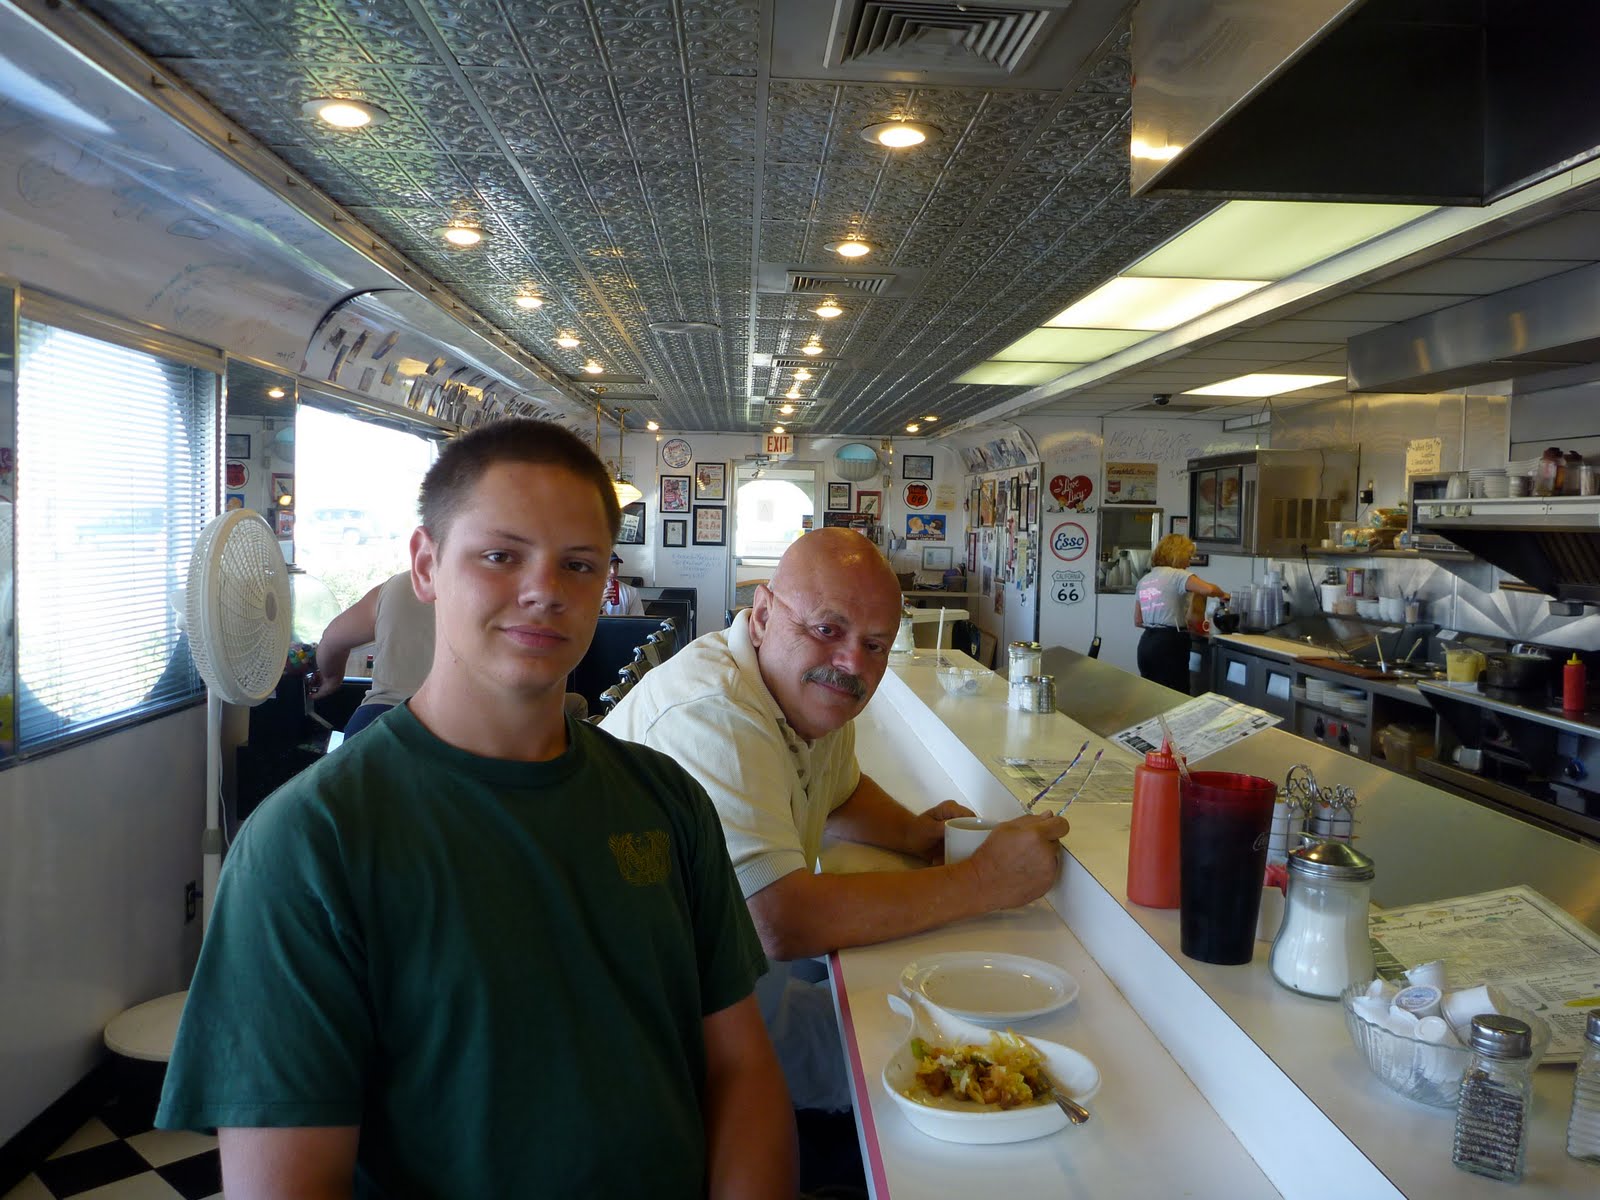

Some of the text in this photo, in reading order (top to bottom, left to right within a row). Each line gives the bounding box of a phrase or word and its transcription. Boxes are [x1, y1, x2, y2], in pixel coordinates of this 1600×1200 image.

[767, 436, 789, 452] EXIT
[1061, 478, 1080, 495] Love
[1054, 532, 1085, 551] Esso
[1057, 588, 1079, 602] 66
